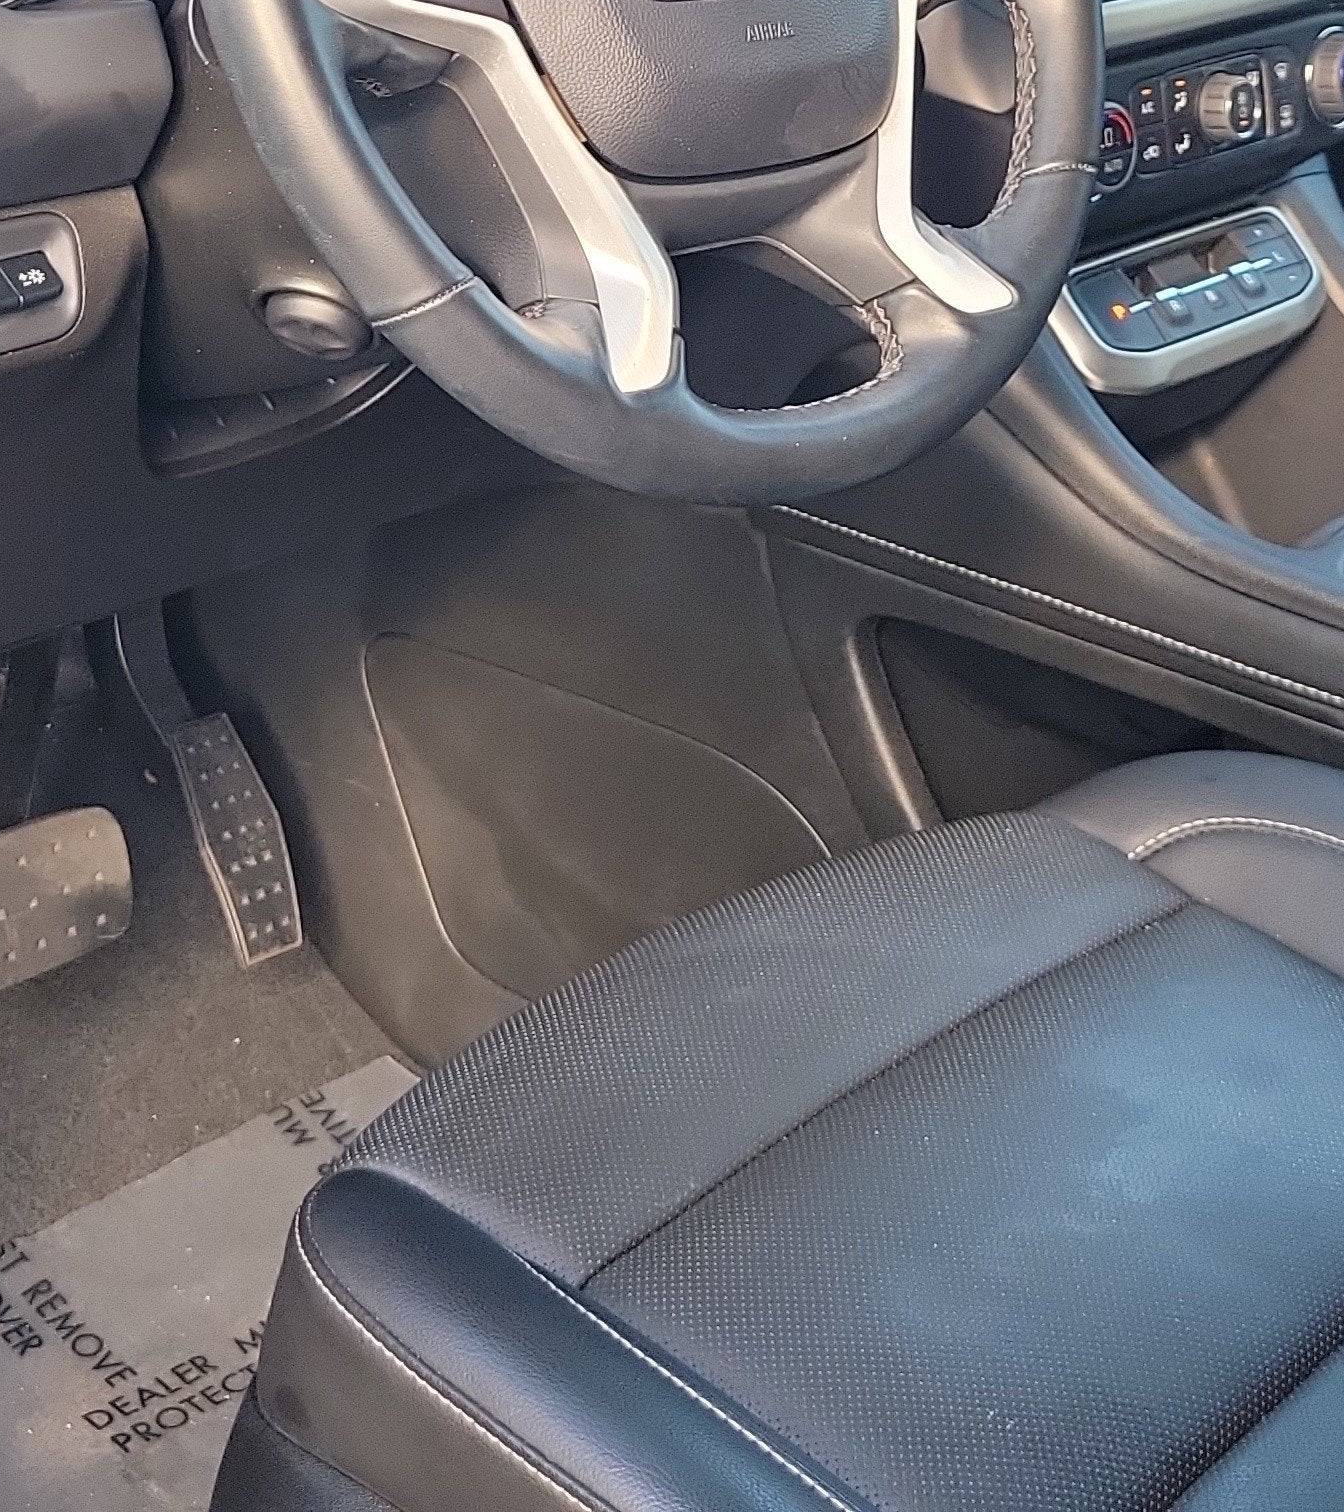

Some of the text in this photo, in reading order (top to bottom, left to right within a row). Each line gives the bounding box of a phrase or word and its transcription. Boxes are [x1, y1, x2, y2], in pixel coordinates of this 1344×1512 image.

[266, 1103, 317, 1146] MU
[300, 1090, 357, 1145] TIVE
[21, 1278, 138, 1388] REMOVE
[80, 1319, 265, 1430] DEALER M
[110, 1362, 257, 1453] PROTECT
